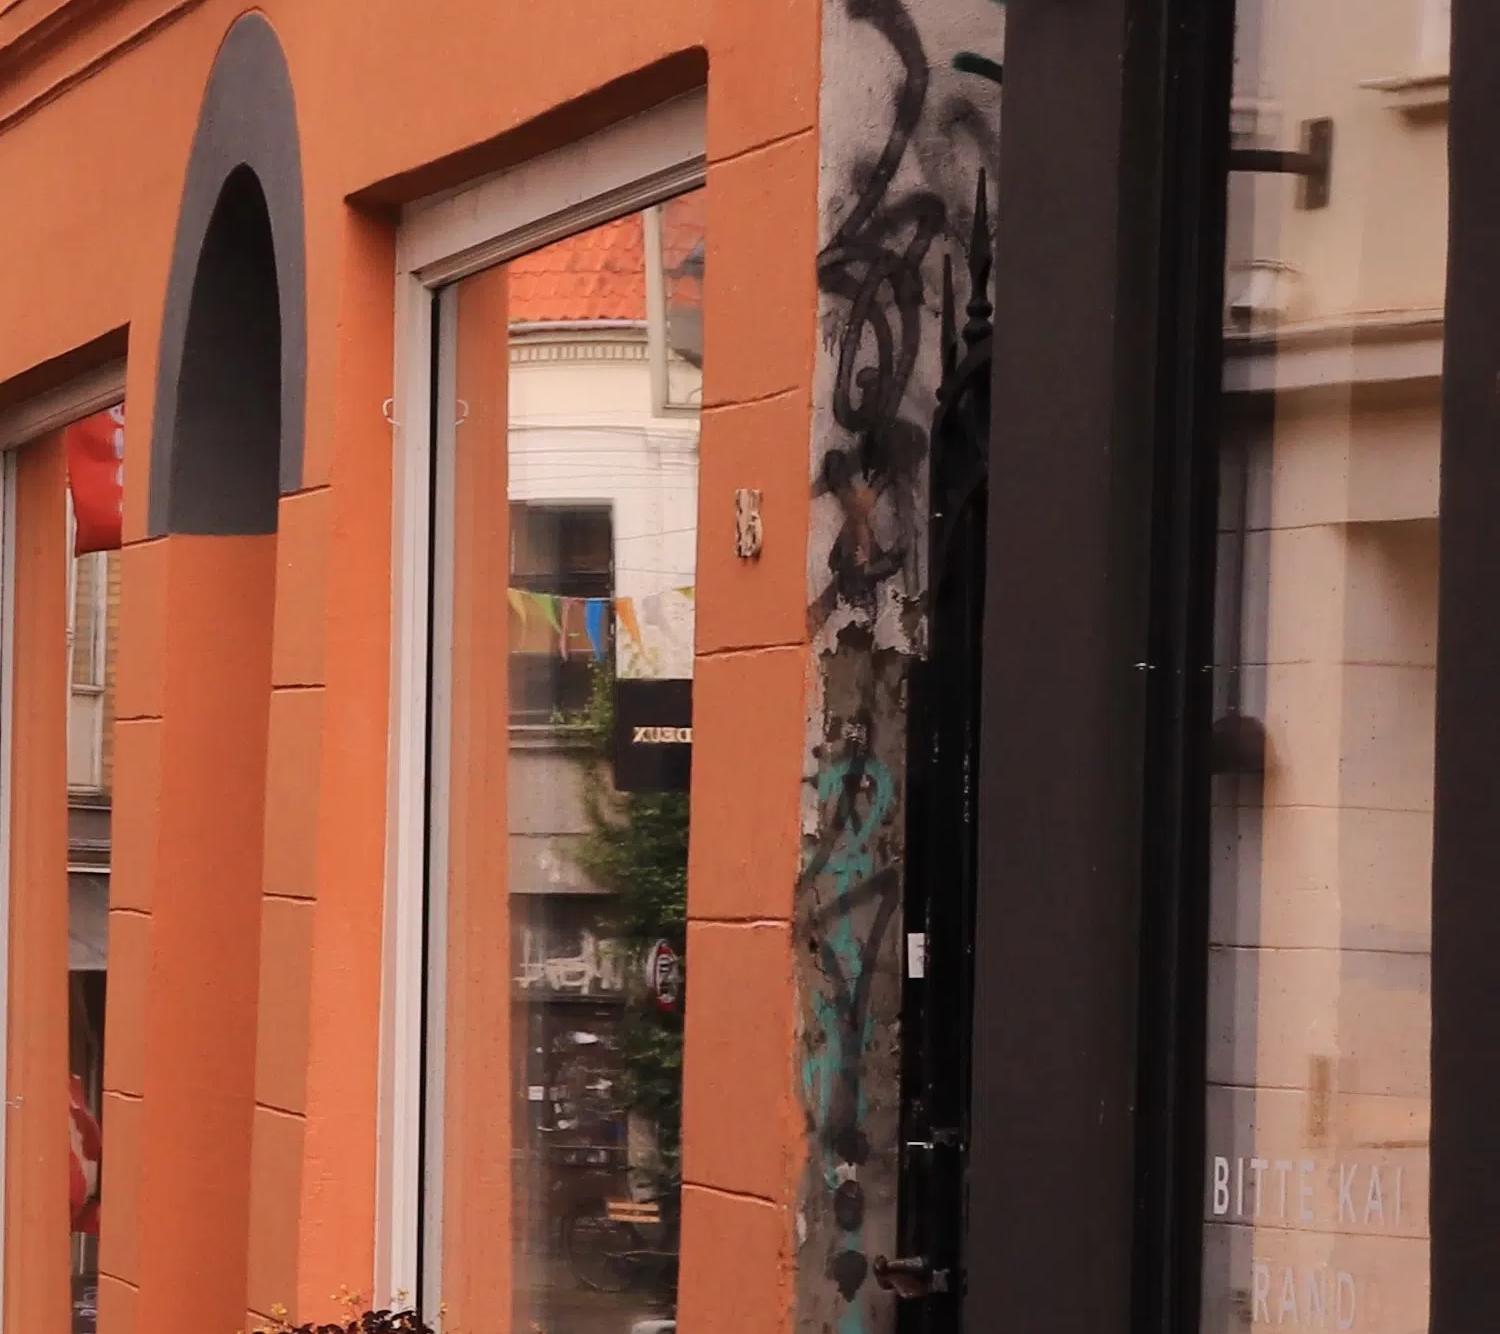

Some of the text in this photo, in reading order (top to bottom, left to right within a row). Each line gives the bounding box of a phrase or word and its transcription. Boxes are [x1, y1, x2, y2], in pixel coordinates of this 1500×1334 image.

[1213, 1156, 1404, 1225] BITTE KAI
[1253, 1264, 1357, 1332] RAND
